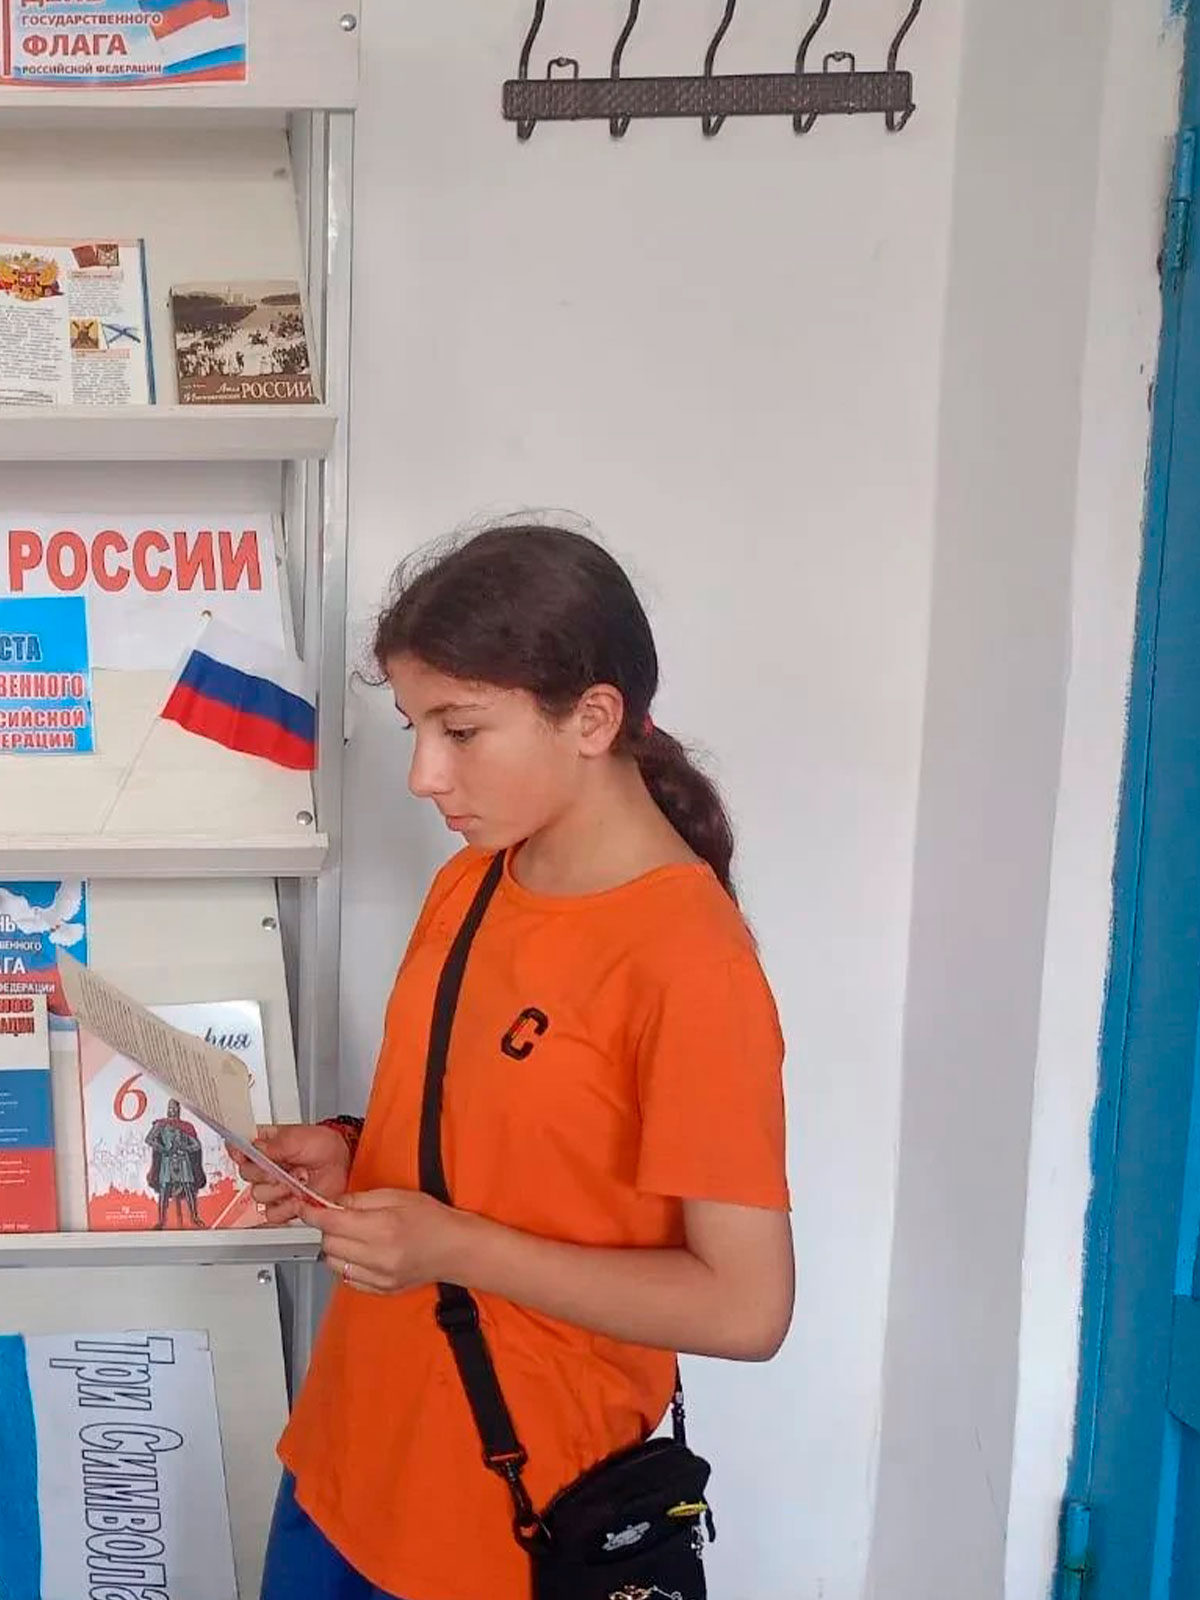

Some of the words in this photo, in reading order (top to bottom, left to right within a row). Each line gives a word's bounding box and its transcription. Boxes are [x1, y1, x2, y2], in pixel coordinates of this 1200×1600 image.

[21, 12, 162, 27] ГОСУДАРСТВЕННОГО
[22, 33, 128, 56] ФЛАГА
[22, 63, 93, 75] РОССИЙСКОЙ
[96, 64, 163, 75] ФЕДЕРАЦИИ
[241, 382, 313, 399] РОССИИ
[8, 530, 262, 592] РОССИИ
[501, 1007, 548, 1061] C
[113, 1072, 148, 1121] 6
[49, 1335, 175, 1411] Три
